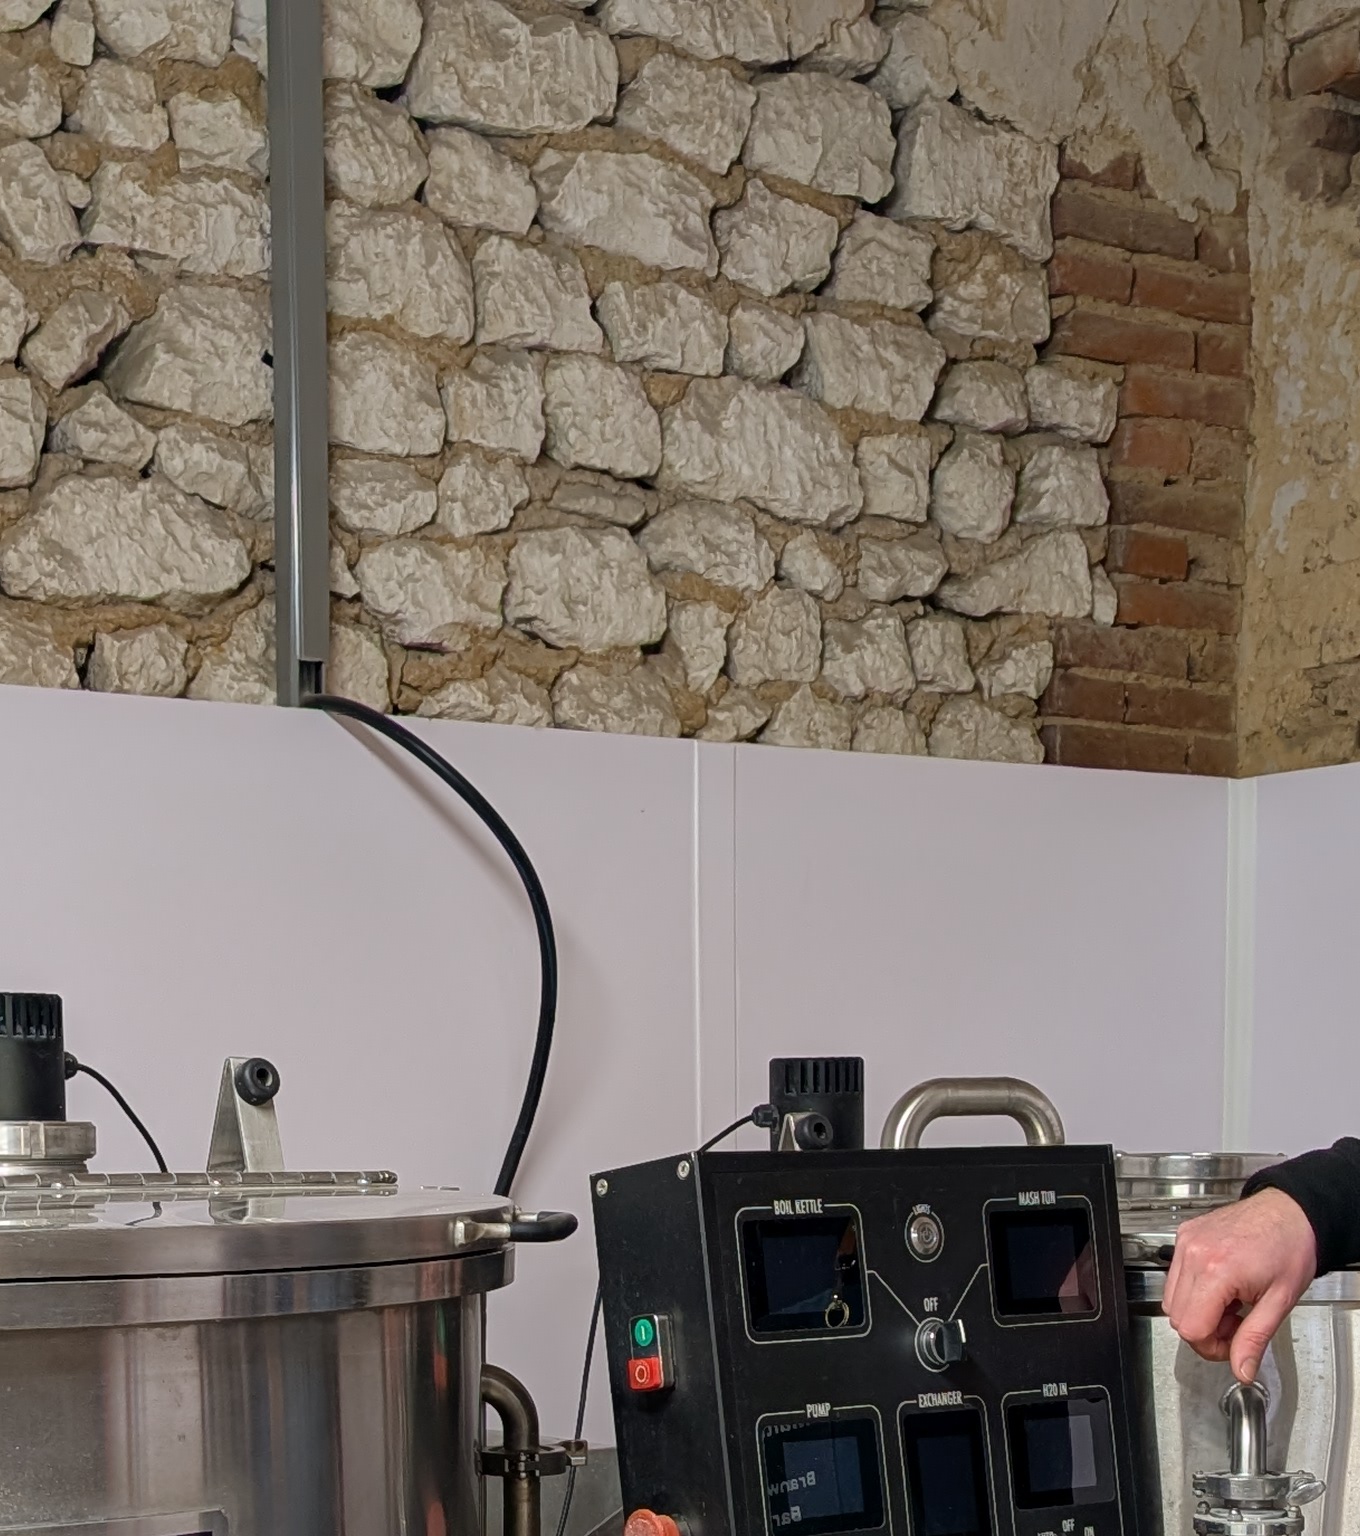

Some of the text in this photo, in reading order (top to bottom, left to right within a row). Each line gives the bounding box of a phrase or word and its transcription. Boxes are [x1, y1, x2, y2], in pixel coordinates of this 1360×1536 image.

[1019, 1191, 1039, 1205] MASH
[774, 1199, 823, 1215] BOIL KETTLE
[923, 1297, 938, 1311] OFF
[918, 1391, 963, 1408] EXCHANGER
[806, 1403, 830, 1418] PUMP
[1062, 1519, 1074, 1532] OFF
